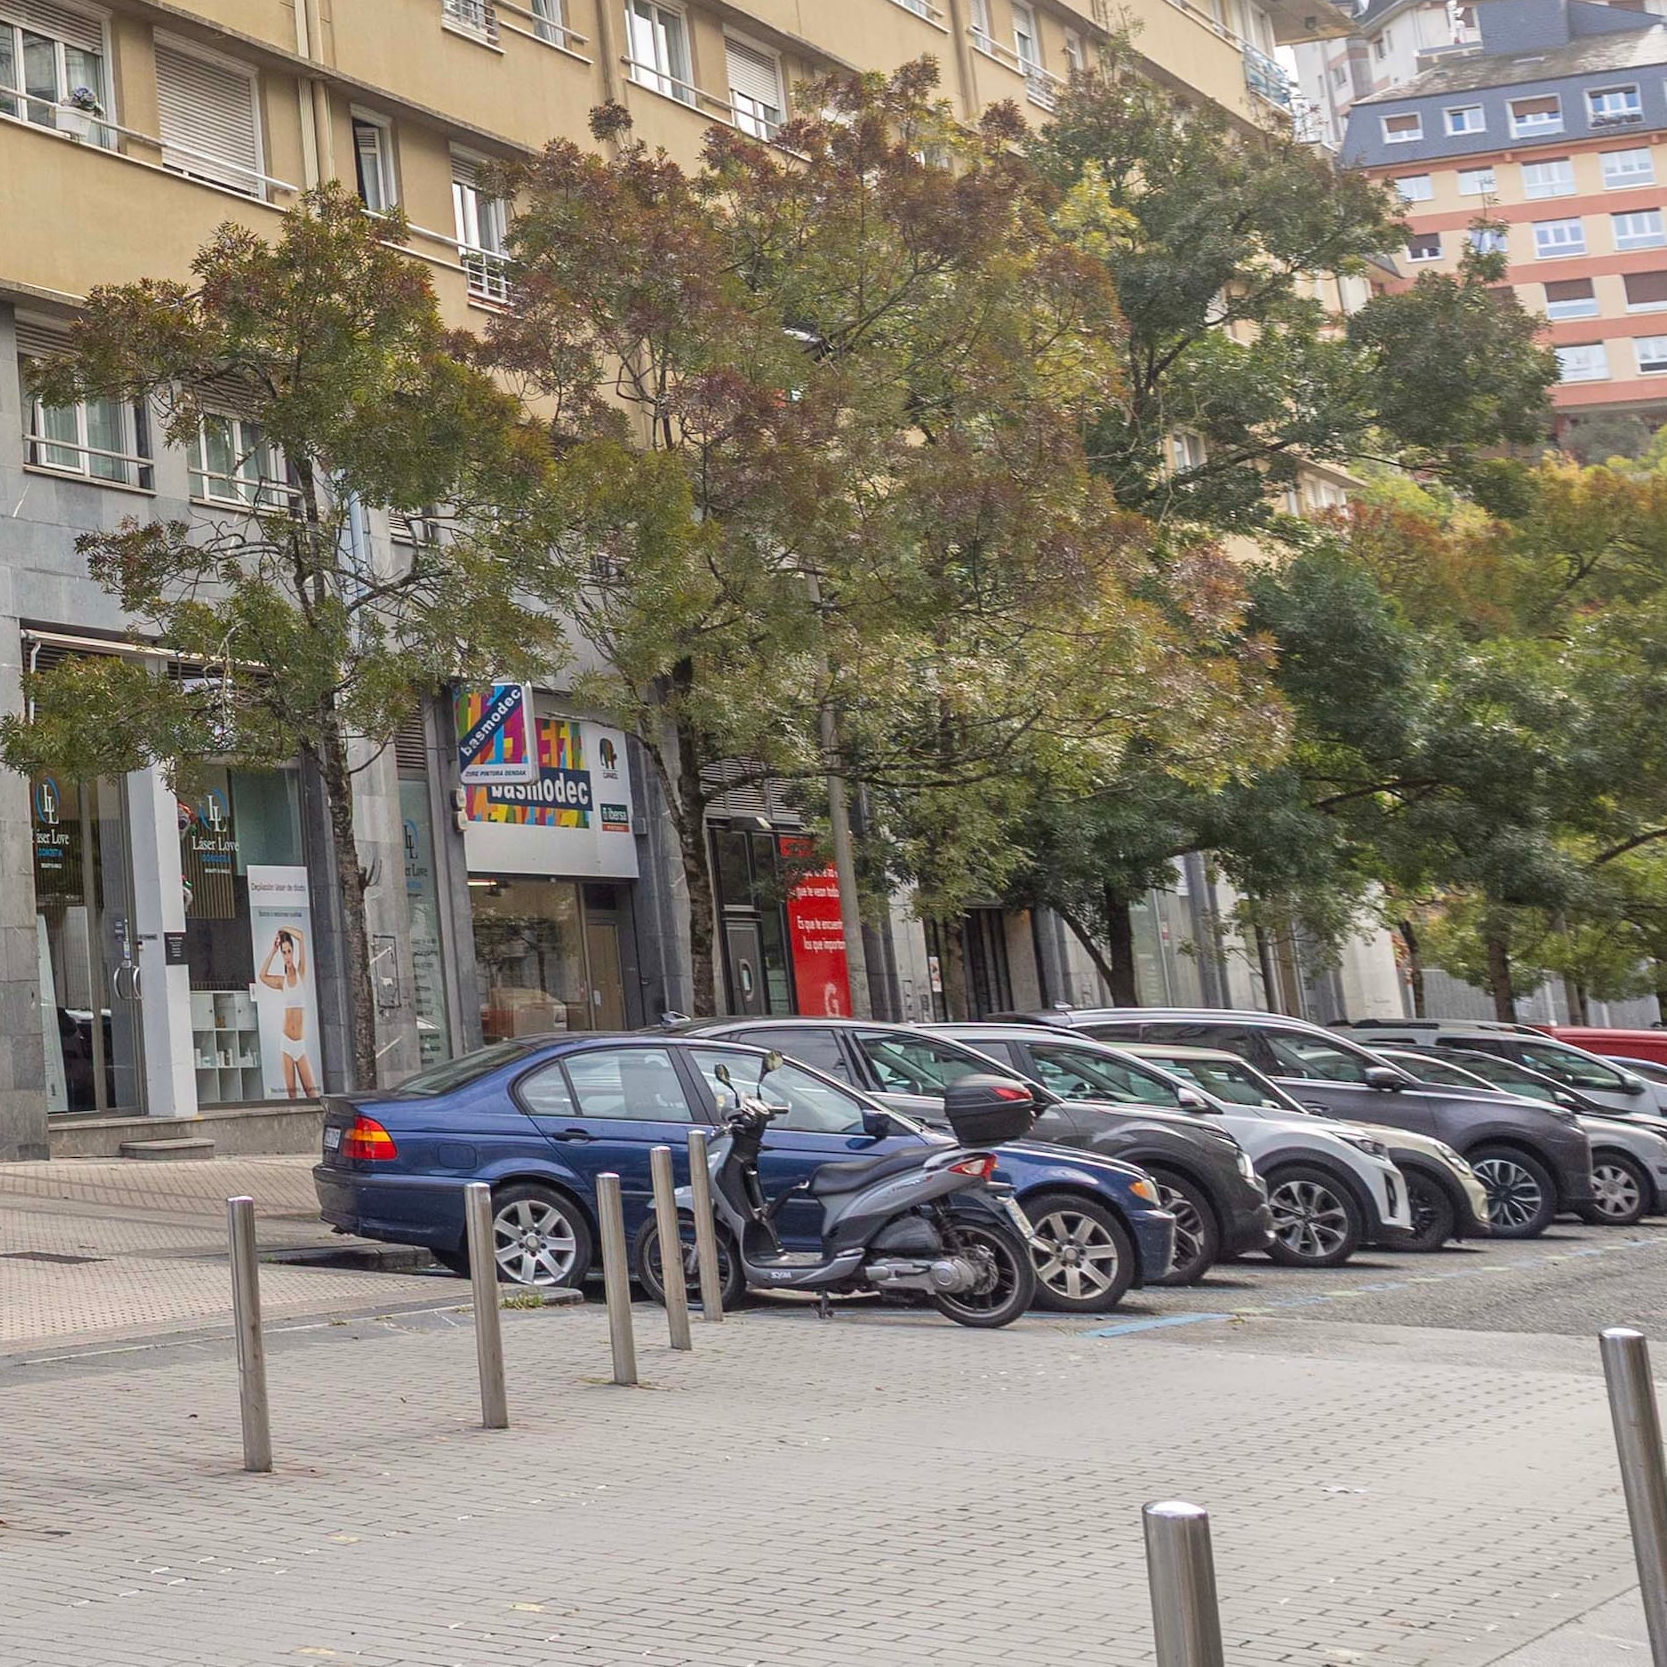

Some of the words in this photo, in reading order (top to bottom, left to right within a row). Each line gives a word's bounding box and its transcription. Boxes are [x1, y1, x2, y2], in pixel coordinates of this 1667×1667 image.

[460, 689, 521, 756] basmodec
[51, 828, 70, 845] Love
[192, 835, 216, 851] Láser
[218, 836, 240, 852] Love
[797, 916, 804, 929] Es
[805, 920, 815, 933] que
[771, 1271, 792, 1279] SYM
